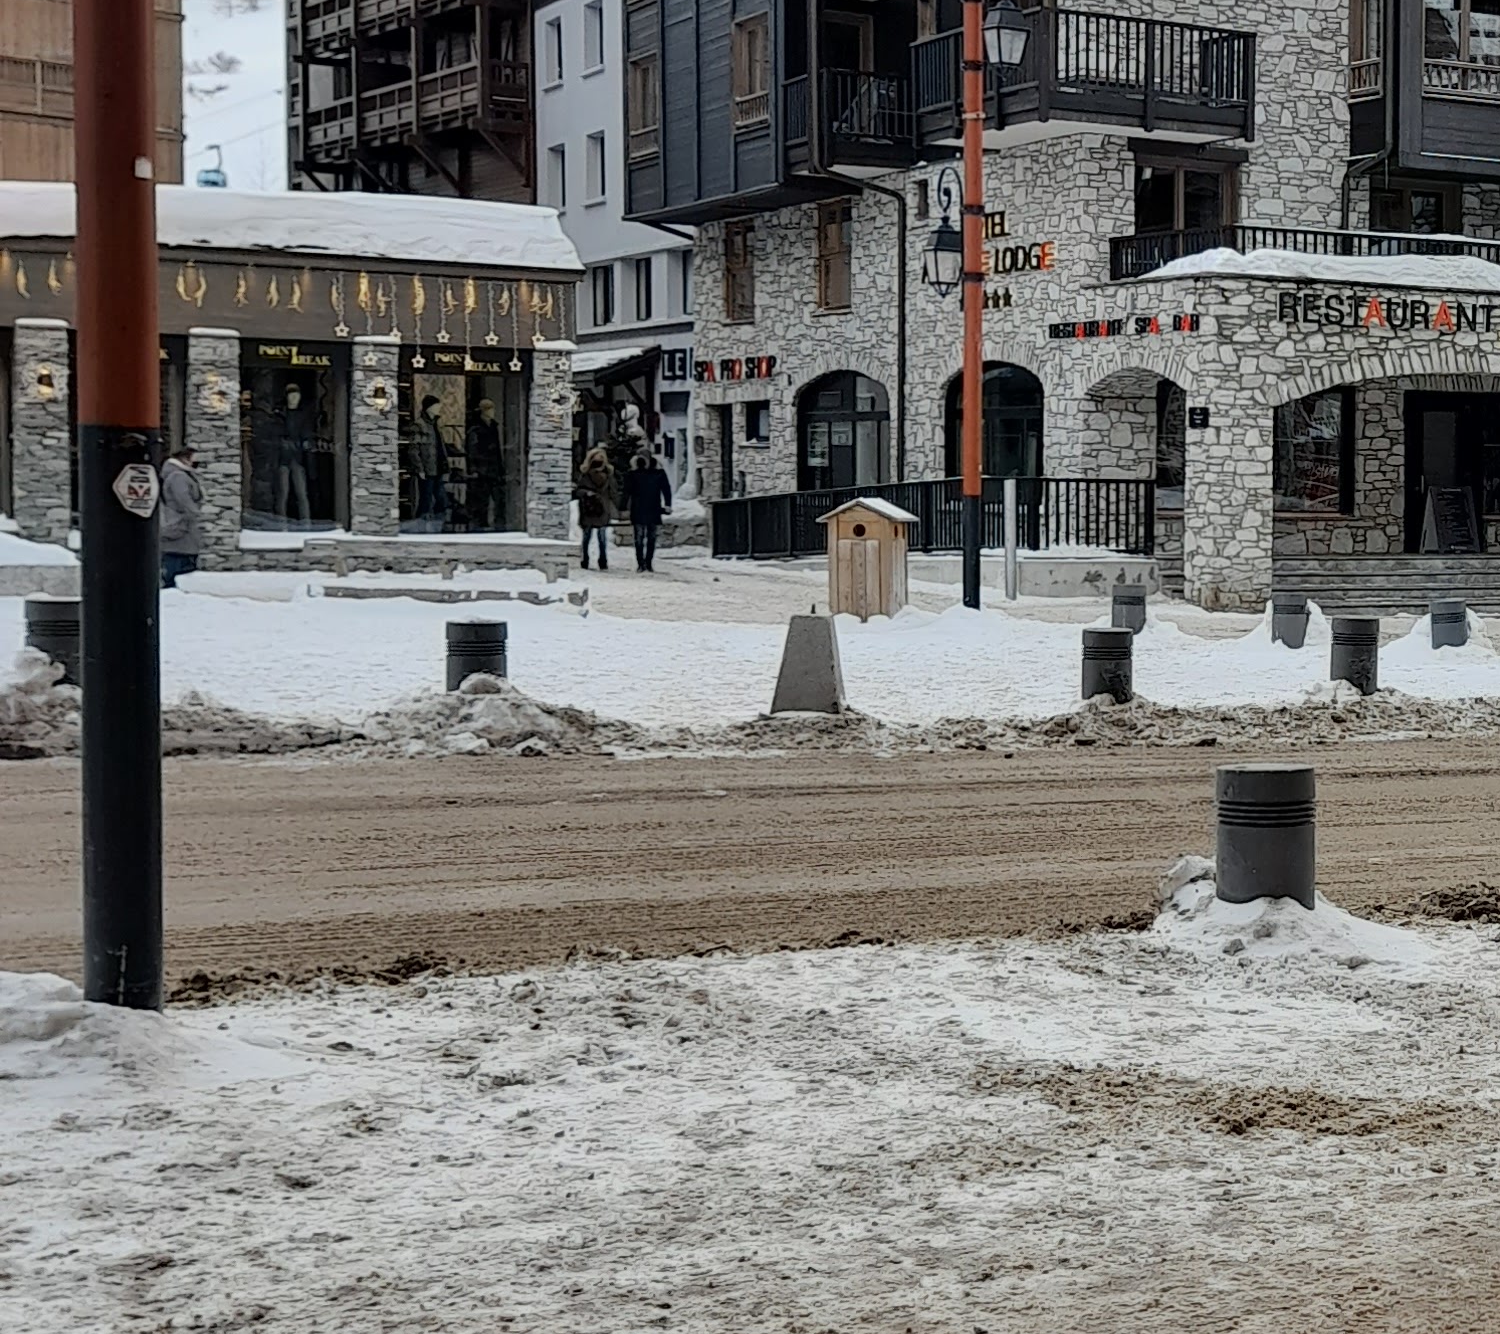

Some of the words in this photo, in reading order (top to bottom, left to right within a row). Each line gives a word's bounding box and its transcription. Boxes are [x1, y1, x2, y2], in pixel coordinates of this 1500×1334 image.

[994, 241, 1055, 274] LODGE
[1134, 315, 1160, 335] SPA
[1173, 314, 1199, 332] BAR
[1277, 292, 1498, 333] RESTAURANT
[663, 353, 684, 377] LE
[694, 360, 716, 383] SPA
[720, 358, 743, 381] PRO
[745, 355, 776, 379] SHOP
